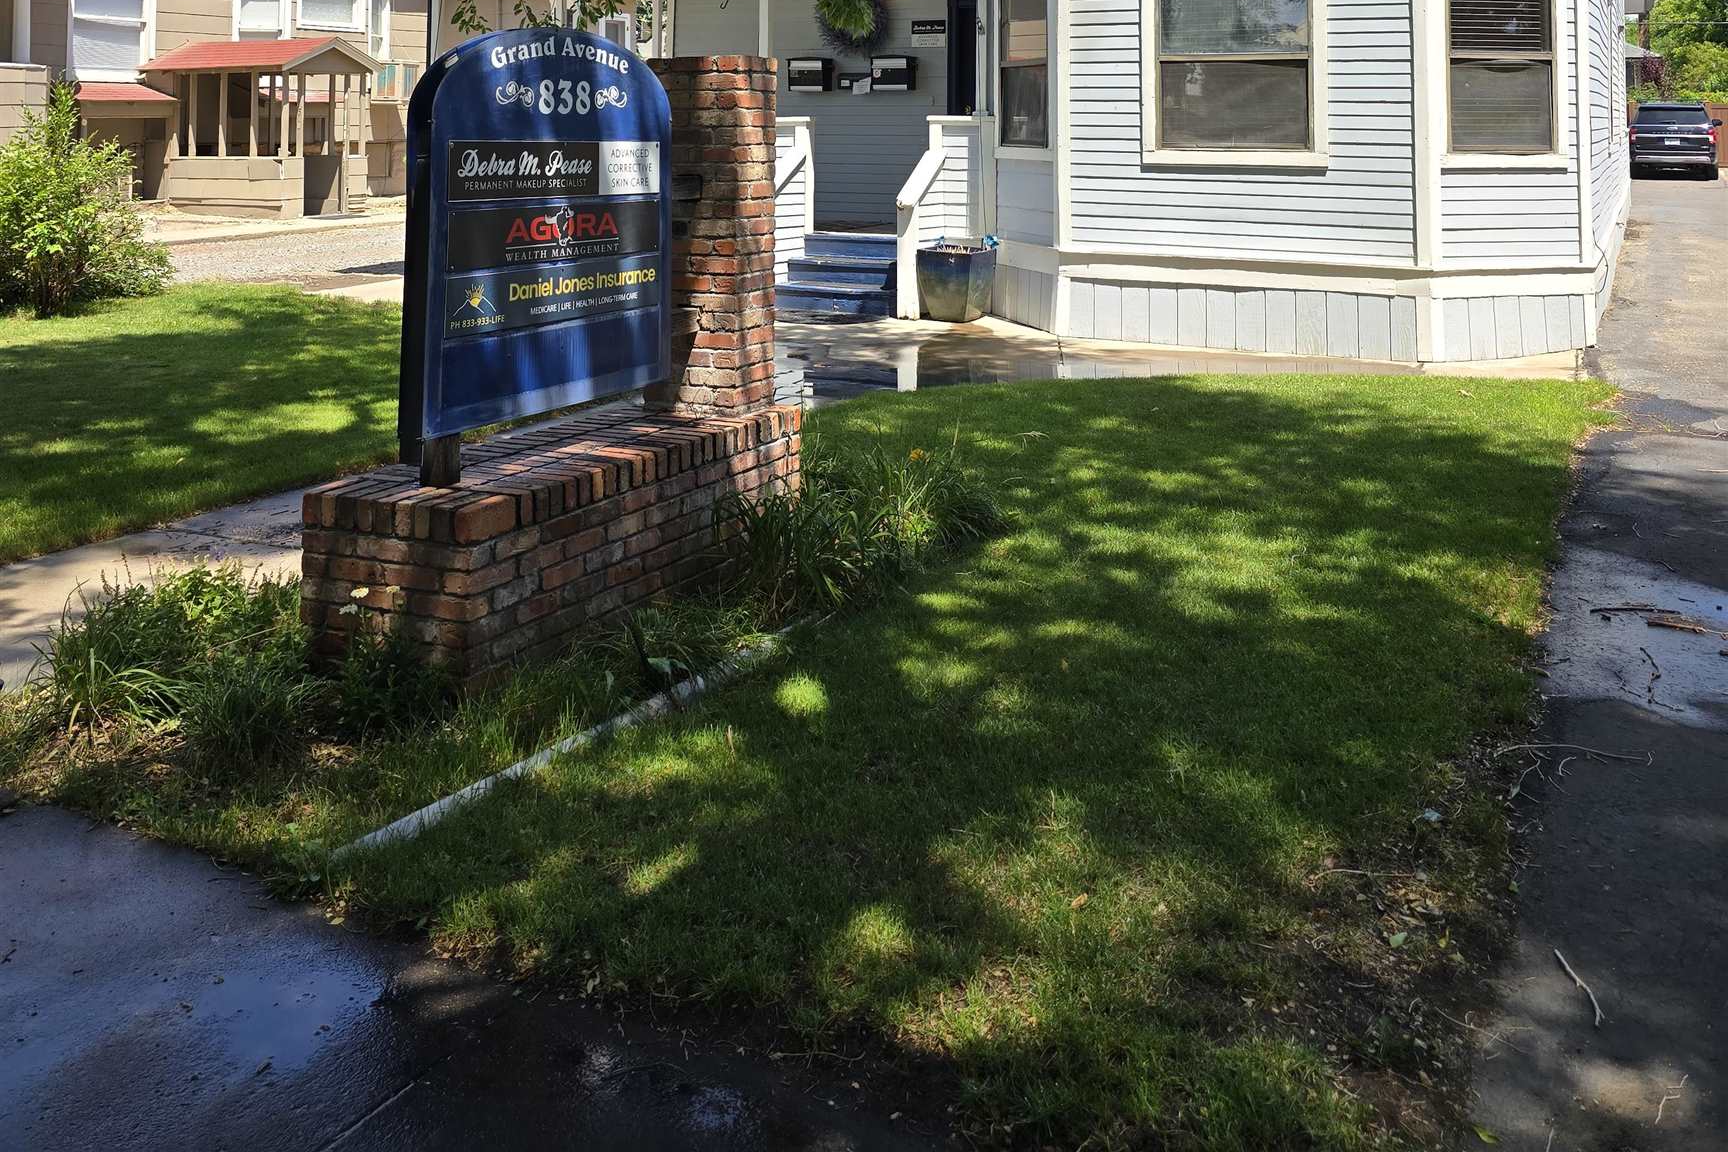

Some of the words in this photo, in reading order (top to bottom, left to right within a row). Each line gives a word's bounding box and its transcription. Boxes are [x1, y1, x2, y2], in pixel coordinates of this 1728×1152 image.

[490, 36, 556, 69] Grand
[561, 37, 629, 74] Avenue
[538, 79, 591, 115] 838
[457, 149, 516, 177] Debra
[517, 151, 541, 176] M.
[545, 150, 593, 176] Pease
[610, 148, 650, 158] ADVANCED
[608, 163, 652, 173] CORRECTIVE
[464, 179, 514, 191] PERMANENT
[516, 179, 547, 190] MAKEUP
[548, 178, 587, 189] SPECIALIST
[611, 177, 629, 188] SKIN
[631, 177, 649, 187] CARE
[504, 211, 619, 244] AGORA
[505, 250, 547, 262] WEALTH
[551, 243, 620, 258] MANAGEMENT
[509, 278, 553, 301] Daniel
[555, 275, 594, 294] Jones
[596, 268, 656, 289] Insurance
[530, 304, 558, 315] MEDICARE
[561, 301, 572, 311] LIFE
[575, 298, 594, 308] HEALTH
[598, 293, 626, 305] LONG-TERM
[626, 291, 639, 301] CARE
[450, 320, 461, 330] PH
[462, 314, 505, 328] 833-933-LIFE
